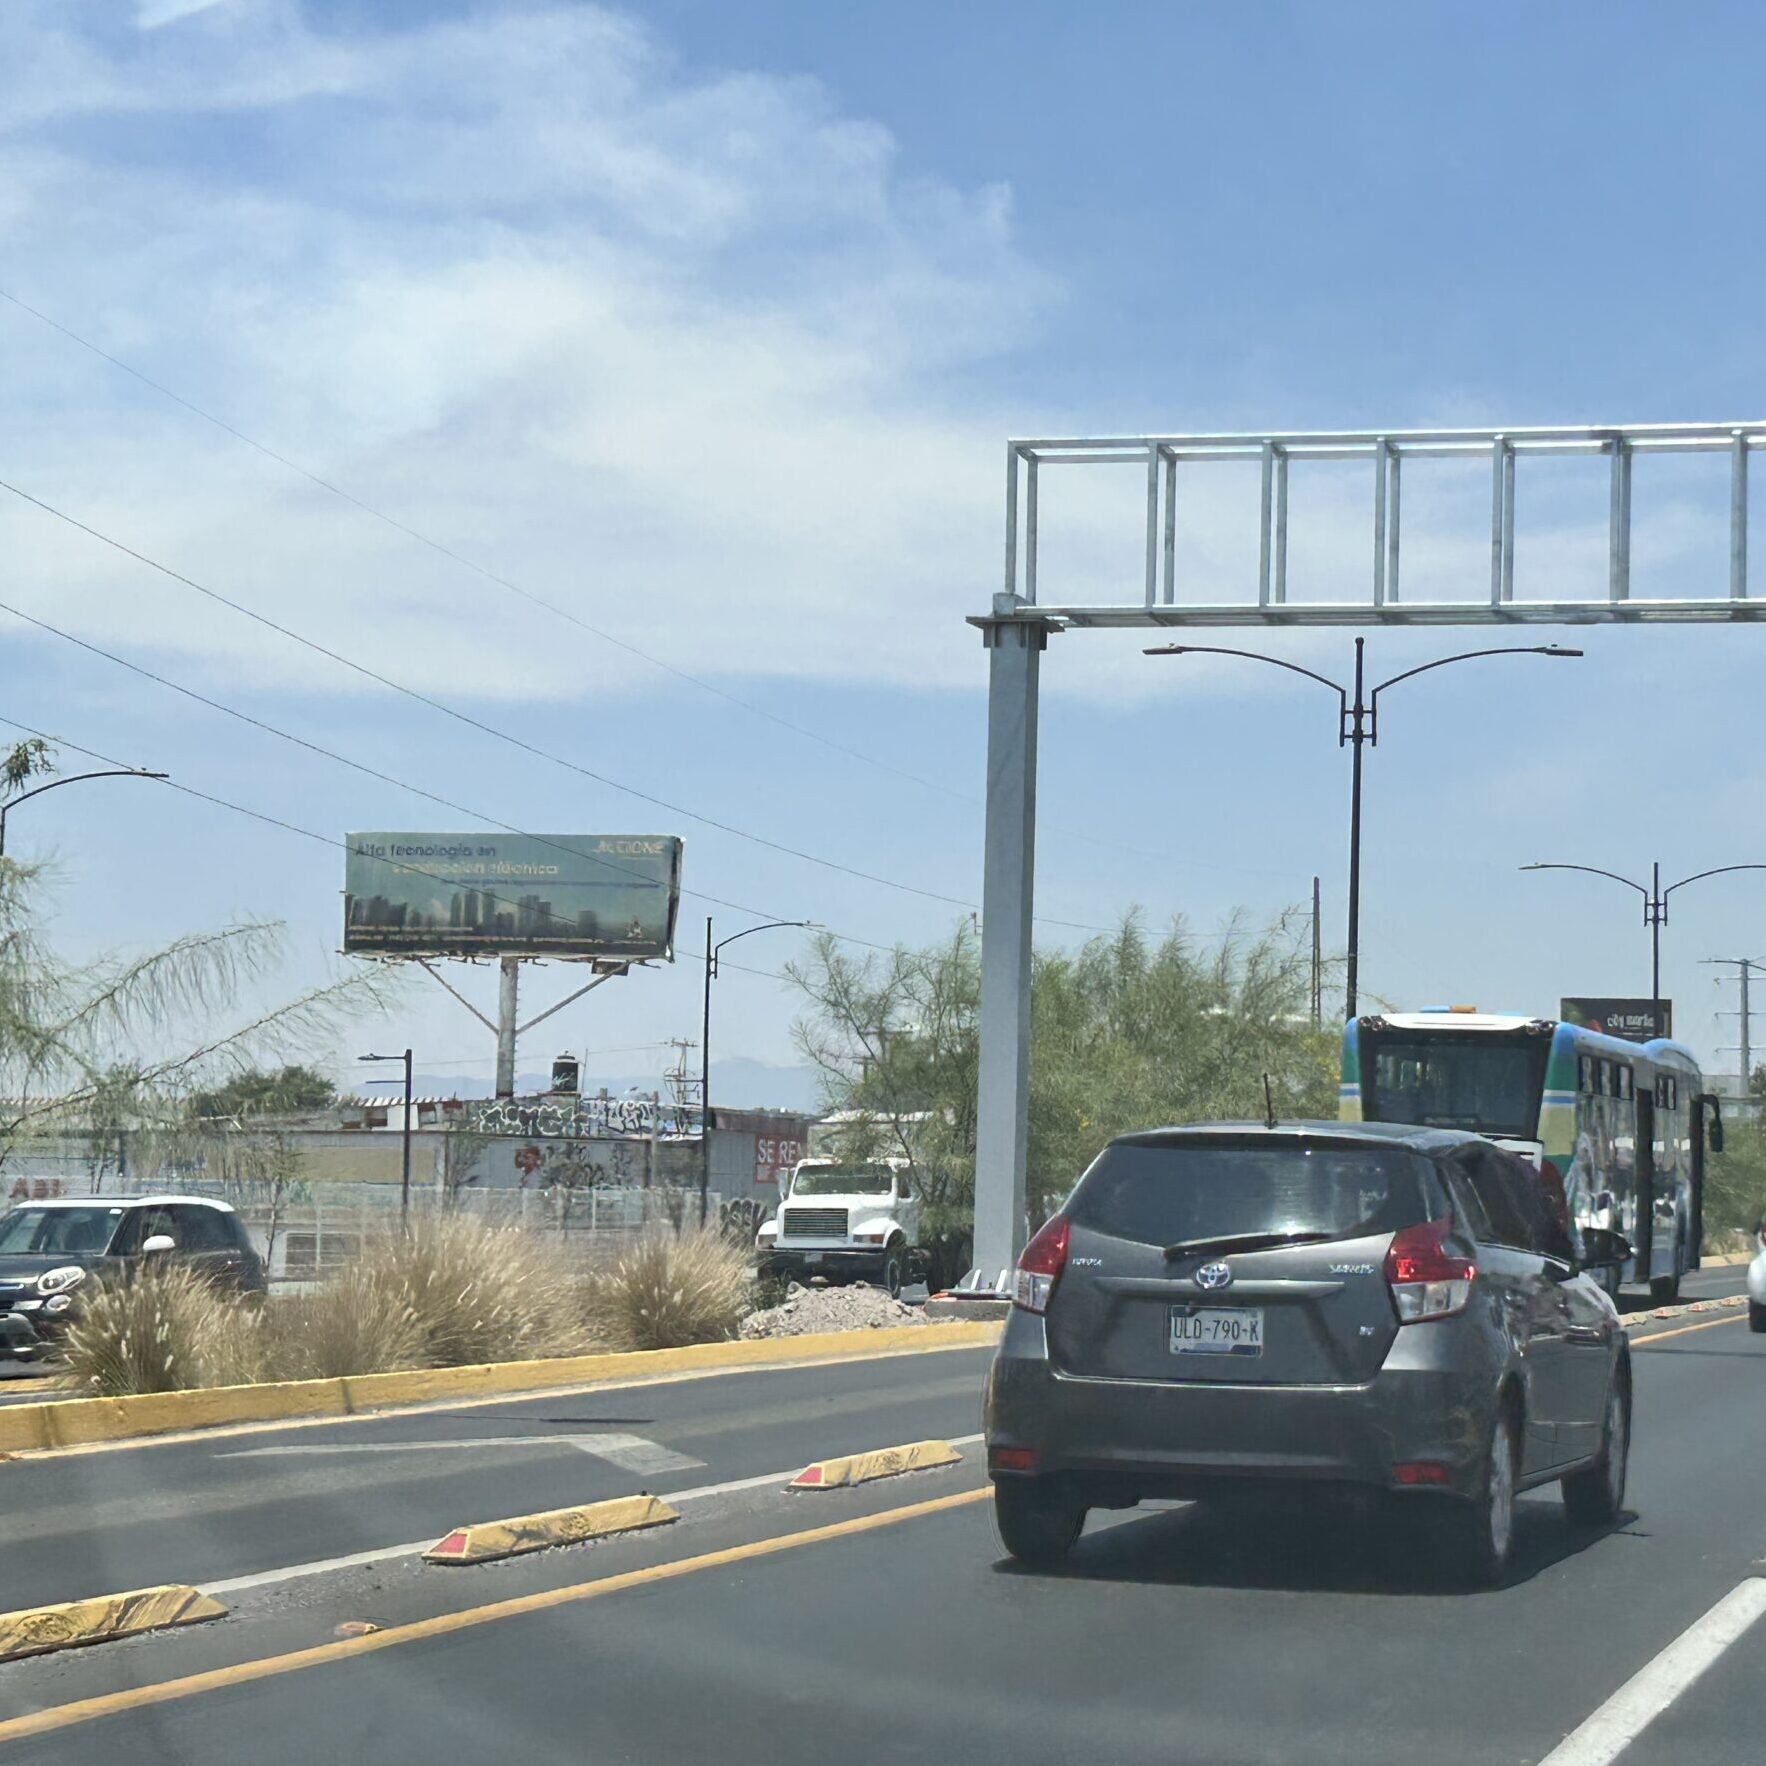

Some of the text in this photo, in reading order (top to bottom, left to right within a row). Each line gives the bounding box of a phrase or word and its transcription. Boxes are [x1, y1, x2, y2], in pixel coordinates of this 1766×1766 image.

[1625, 1013, 1655, 1027] marke
[758, 1137, 775, 1164] SE
[1174, 1316, 1259, 1342] ULD-790-K
